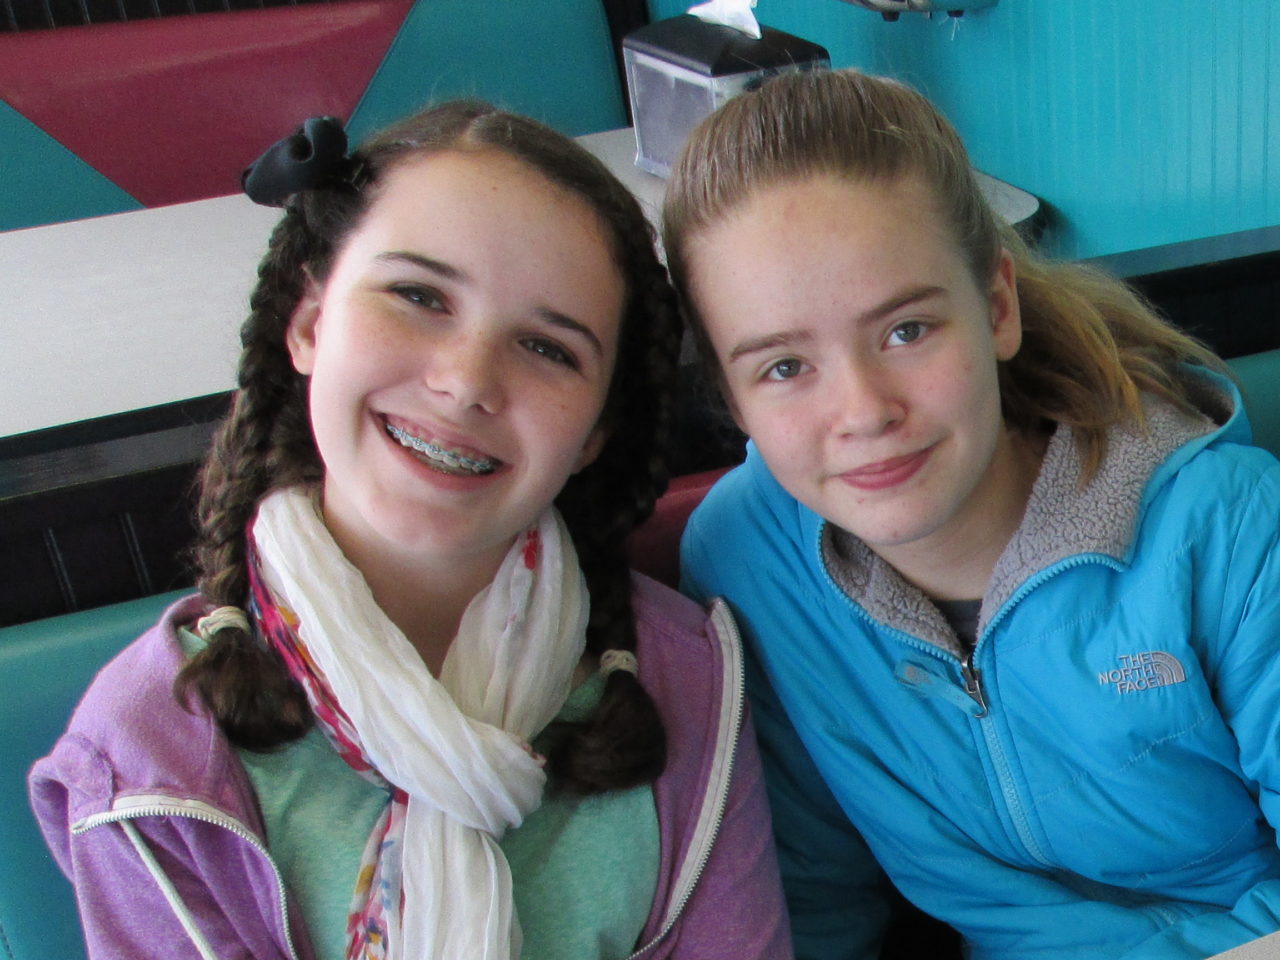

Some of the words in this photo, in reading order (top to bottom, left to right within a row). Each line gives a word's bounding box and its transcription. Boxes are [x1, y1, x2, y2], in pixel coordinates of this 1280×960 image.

[1119, 652, 1152, 669] THE
[1097, 663, 1156, 686] NORTH
[1117, 677, 1159, 695] FACE
